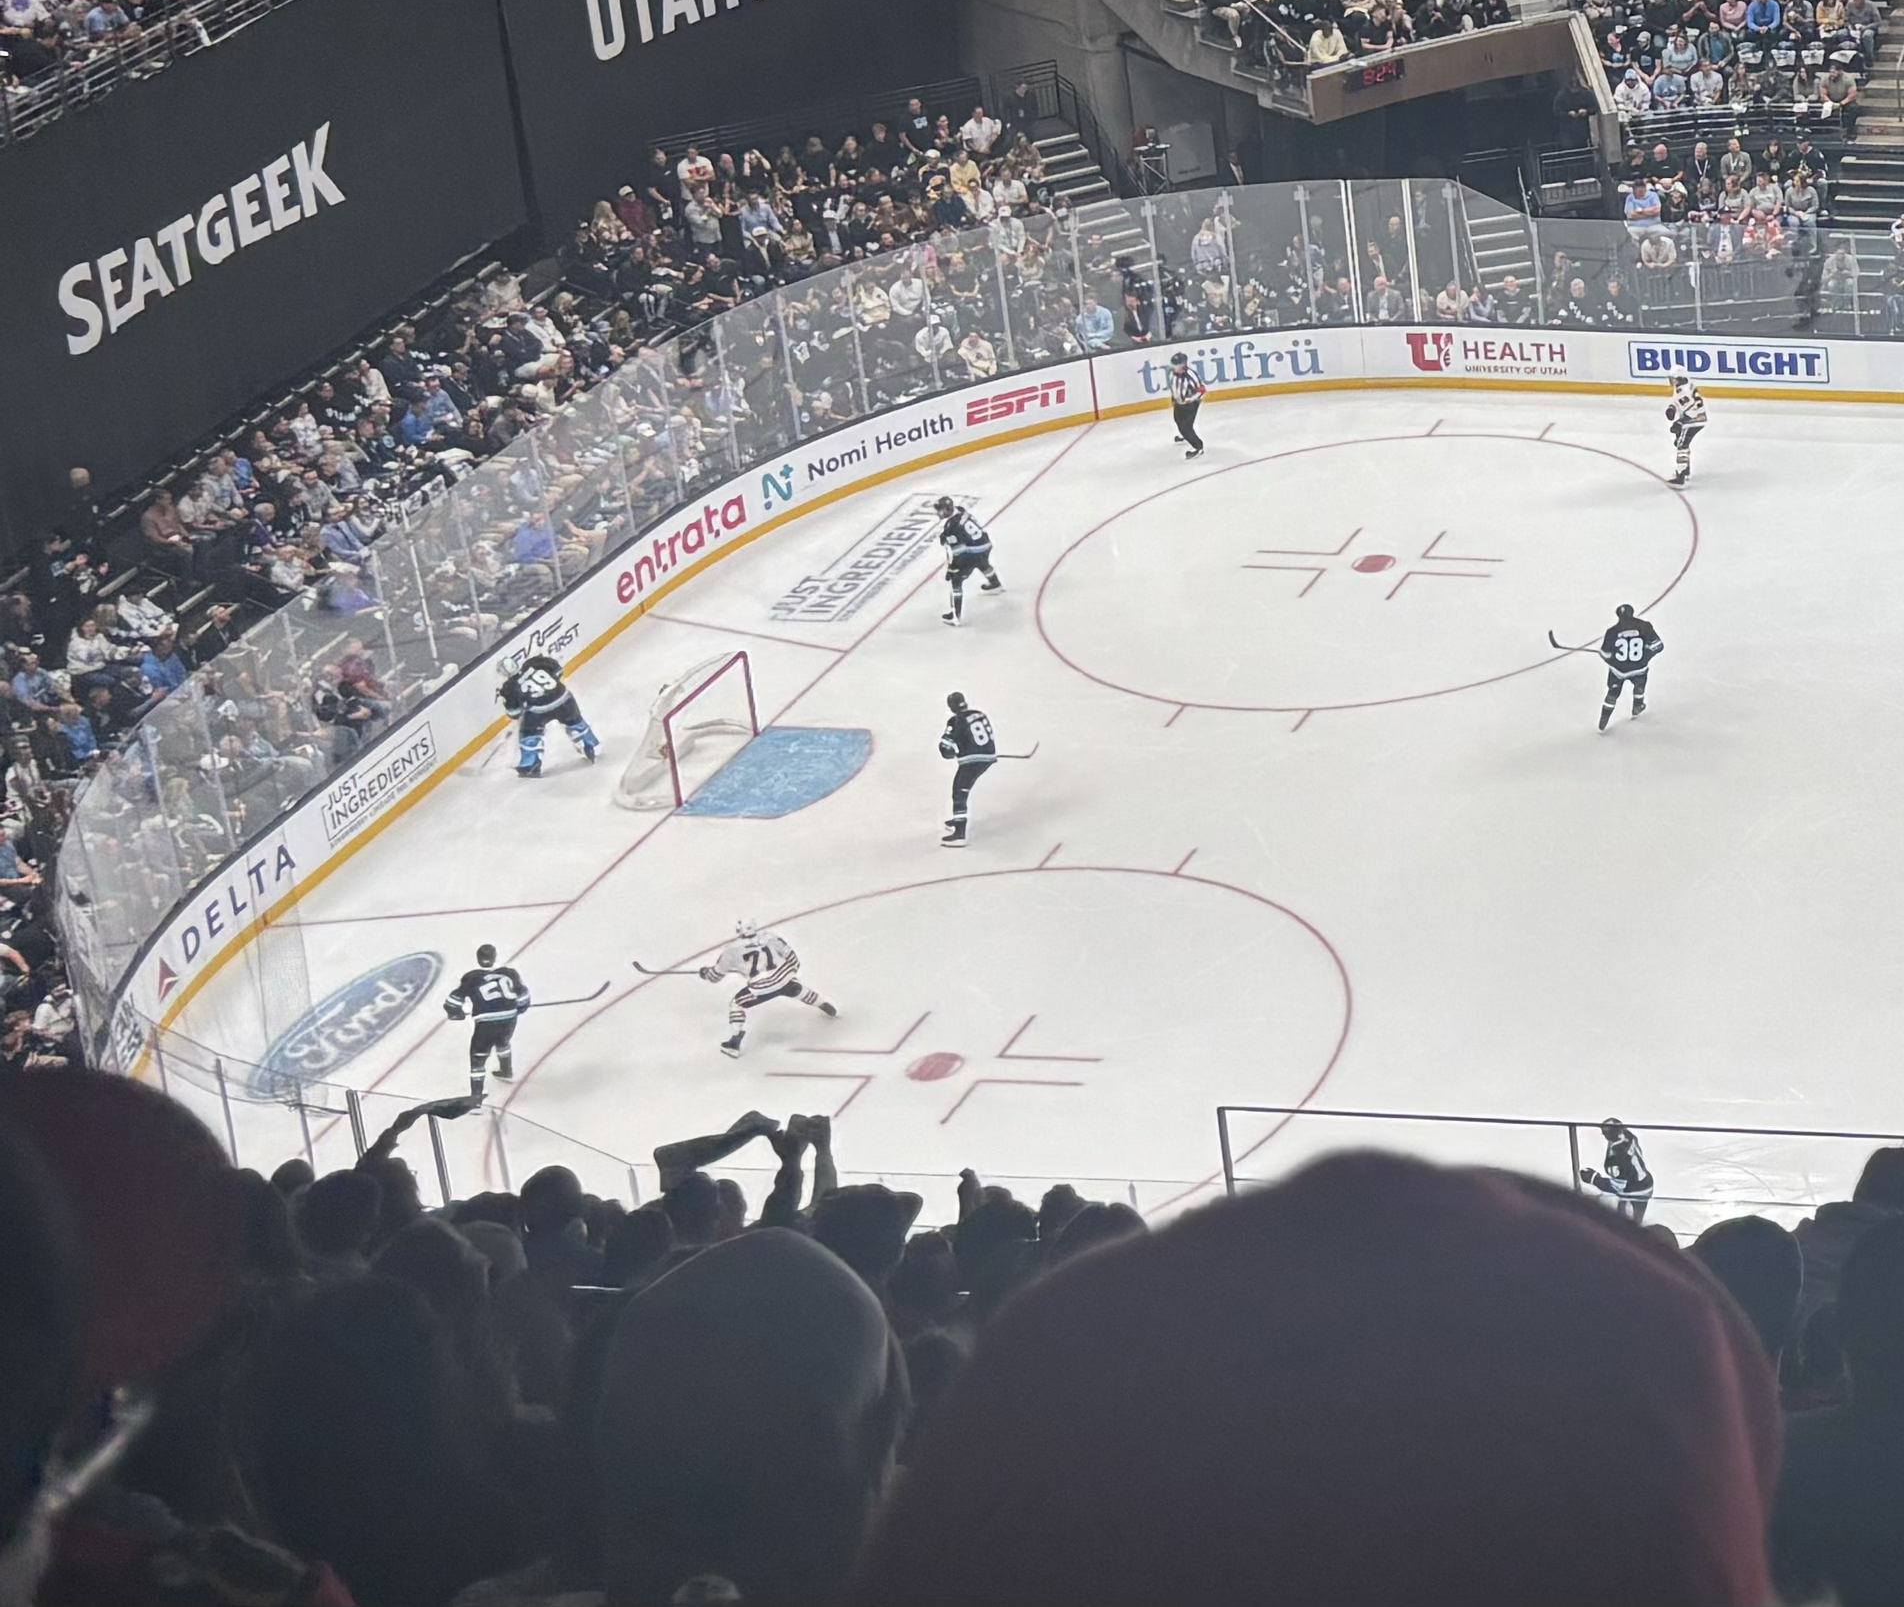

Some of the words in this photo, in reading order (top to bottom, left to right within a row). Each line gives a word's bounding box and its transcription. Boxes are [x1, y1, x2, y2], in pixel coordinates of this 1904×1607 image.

[56, 120, 347, 357] SEATGEEK
[1461, 340, 1568, 365] HEALTH
[1464, 363, 1518, 375] UNIVERSITY
[1522, 365, 1536, 375] OF
[1539, 365, 1568, 376] UTAH
[1636, 348, 1710, 374] BUD
[1717, 352, 1824, 380] LIGHT
[966, 379, 1066, 426] ESPN
[807, 440, 868, 481] Nomi
[874, 411, 955, 453] Health
[618, 493, 746, 606] entrata
[1613, 637, 1645, 662] 38
[325, 772, 361, 810] JUST
[329, 737, 434, 829] INGREDIENTS
[181, 843, 296, 963] DELTA
[741, 947, 775, 976] 71
[283, 973, 413, 1070] Ford
